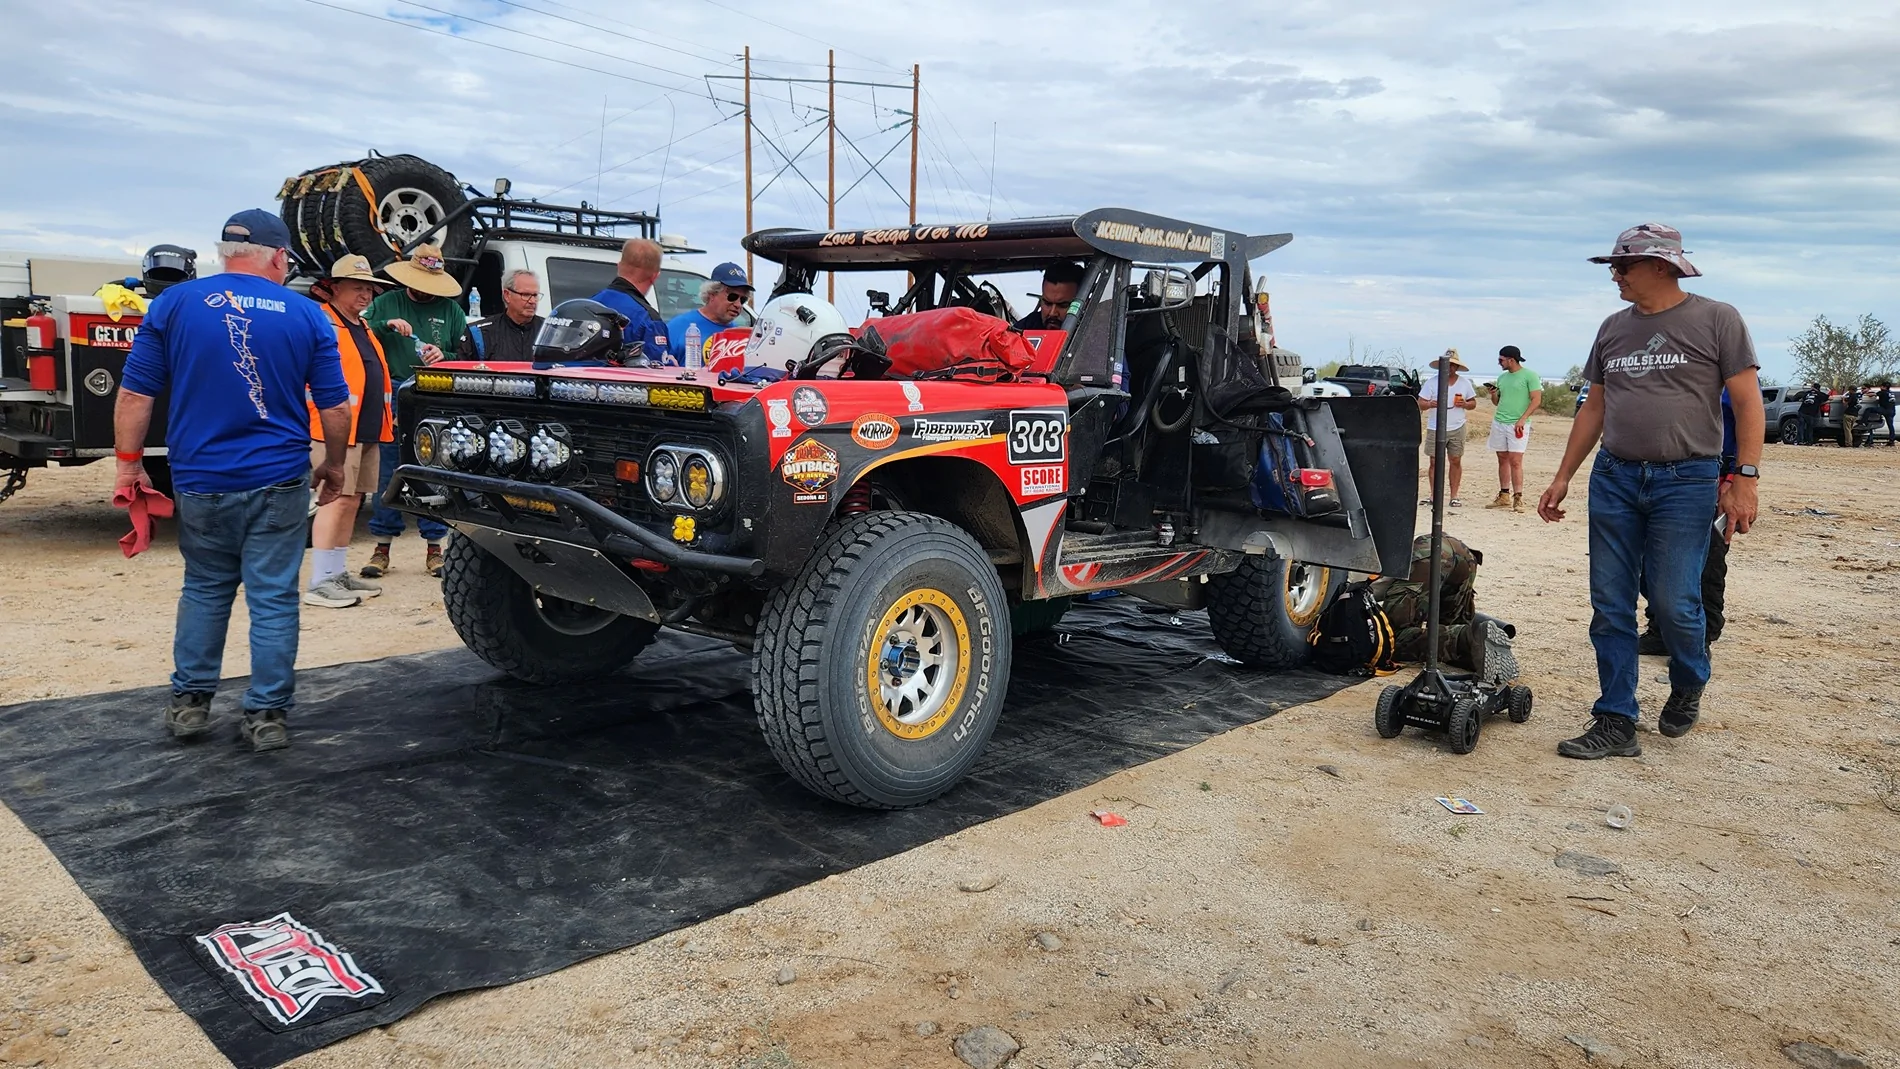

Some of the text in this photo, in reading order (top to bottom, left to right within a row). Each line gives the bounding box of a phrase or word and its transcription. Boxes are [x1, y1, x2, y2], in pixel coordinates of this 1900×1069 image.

[818, 231, 856, 247] Love
[862, 229, 910, 246] Reign
[955, 223, 989, 239] Me
[256, 297, 287, 313] RACING
[95, 325, 121, 342] GET
[1012, 420, 1063, 454] 303
[783, 460, 838, 476] OUTBACK
[1023, 468, 1061, 486] SCORE
[953, 586, 992, 742] BFGoodrich
